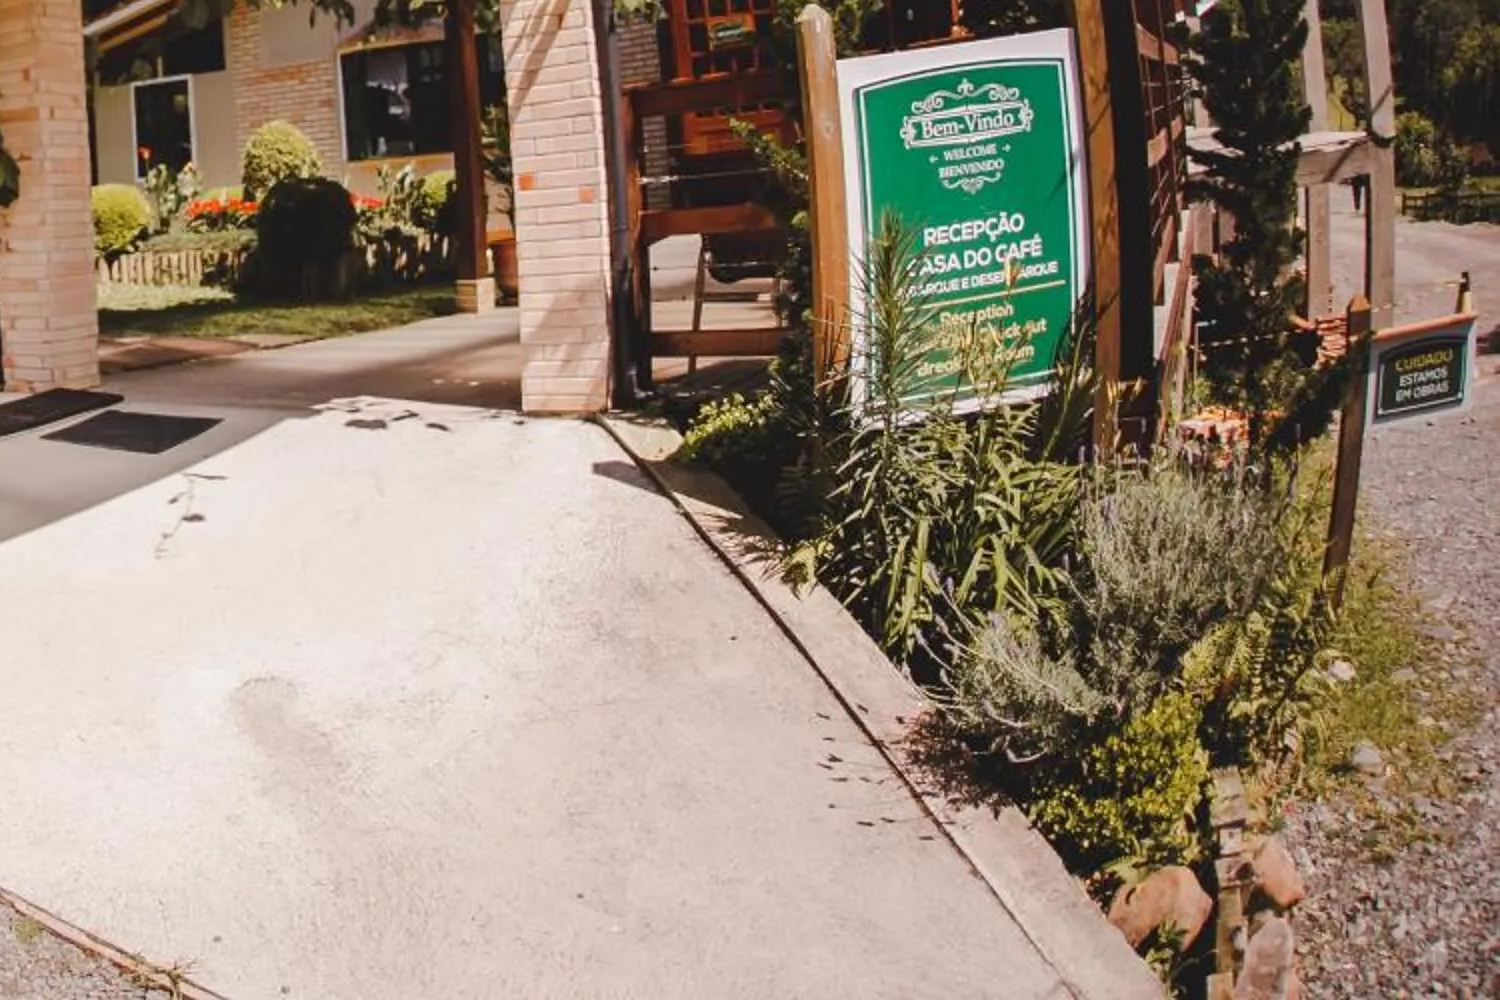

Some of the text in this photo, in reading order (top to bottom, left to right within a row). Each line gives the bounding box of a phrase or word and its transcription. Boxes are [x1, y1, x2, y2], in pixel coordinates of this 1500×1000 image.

[920, 107, 1015, 139] Bem-Vindo
[943, 143, 998, 162] WELCOME
[923, 211, 1025, 247] RECEPÇÃO
[963, 247, 993, 269] DO
[995, 233, 1043, 264] CAFÉ
[961, 276, 971, 289] E
[1399, 365, 1448, 387] ESTAMOS
[1413, 380, 1449, 398] OBRAS
